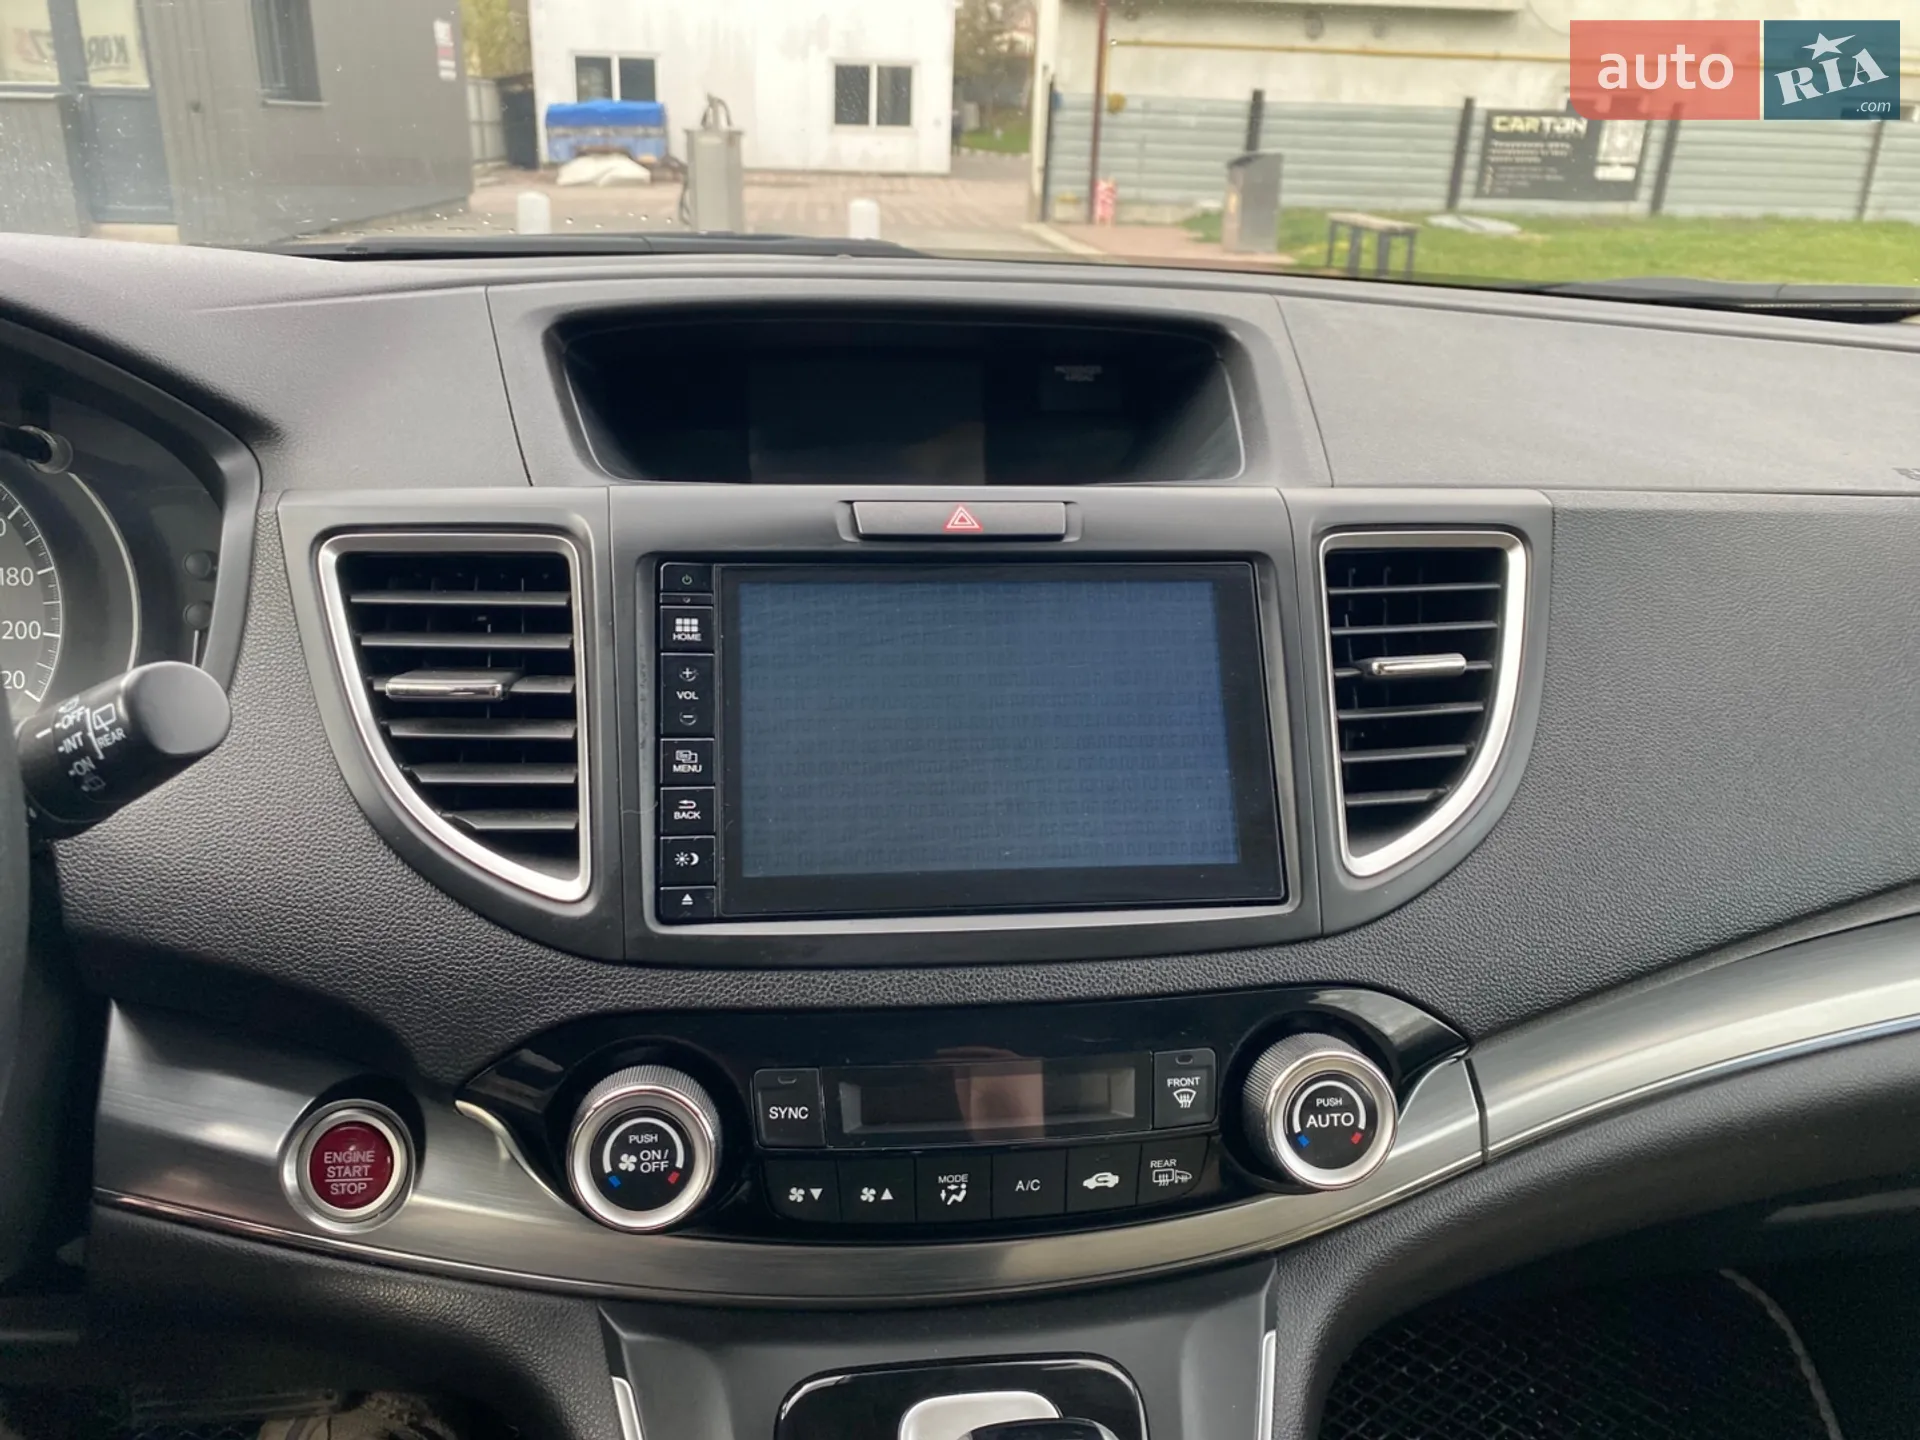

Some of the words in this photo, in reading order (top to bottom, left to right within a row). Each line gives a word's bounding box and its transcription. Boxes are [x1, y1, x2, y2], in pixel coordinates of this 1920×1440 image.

[2, 620, 41, 640] 200
[672, 632, 702, 642] HOME
[676, 690, 699, 700] VOL
[61, 705, 85, 730] OFF
[63, 731, 84, 754] INT
[97, 727, 127, 750] REAR
[73, 756, 97, 776] ON
[672, 764, 703, 773] MENU
[673, 811, 702, 820] BACK
[1167, 1076, 1201, 1088] FRONT
[1316, 1097, 1343, 1107] PUSH
[769, 1106, 809, 1120] SYNC
[1306, 1112, 1355, 1128] AUTO
[628, 1134, 659, 1144] PUSH
[323, 1150, 376, 1164] ENGINE
[1150, 1158, 1177, 1169] REAR
[326, 1165, 372, 1178] START
[640, 1160, 670, 1174] OFF
[937, 1174, 968, 1184] MODE
[330, 1182, 368, 1195] STOP
[1015, 1179, 1041, 1193] A/C
